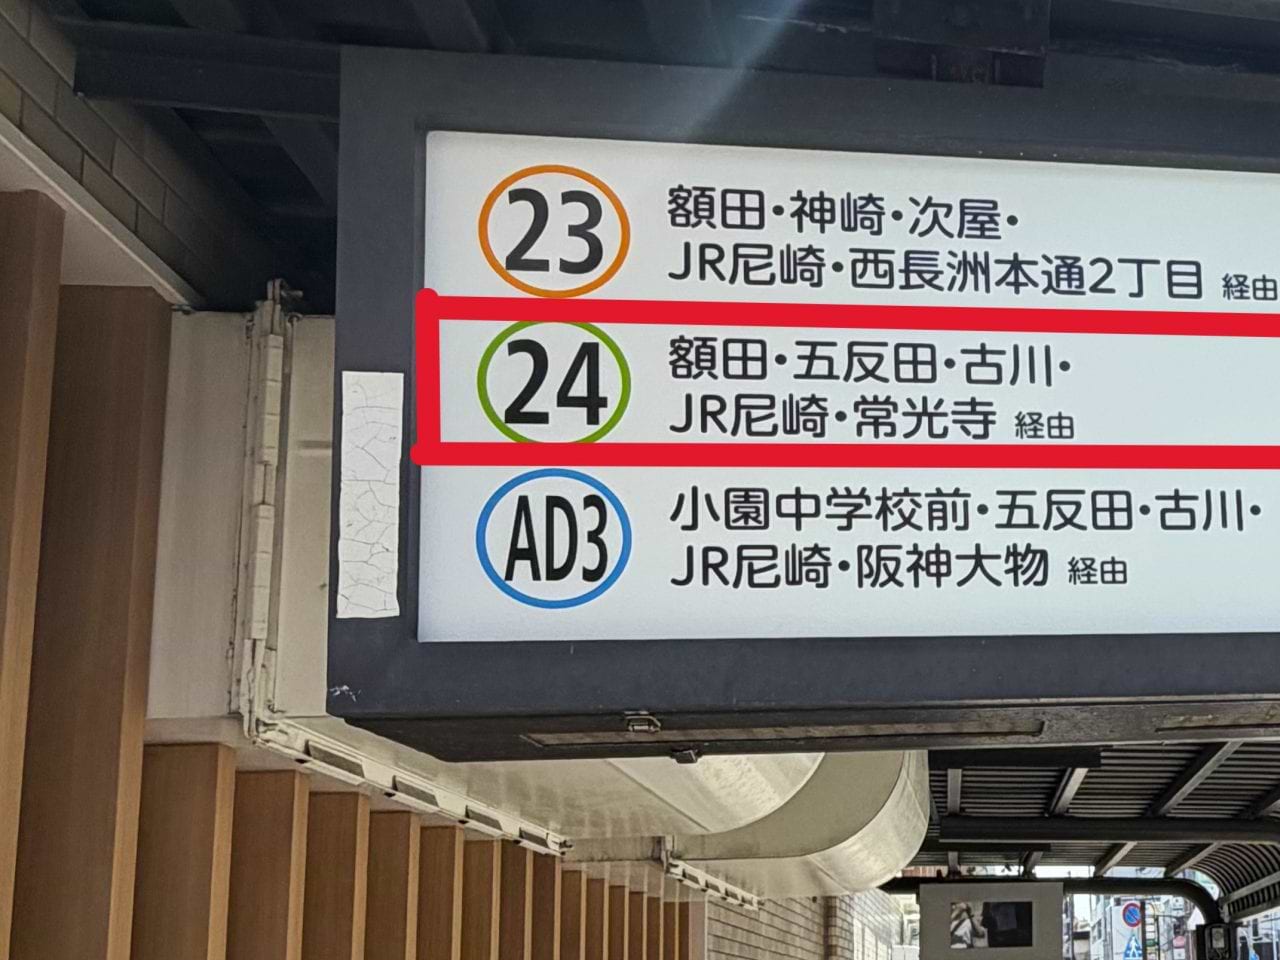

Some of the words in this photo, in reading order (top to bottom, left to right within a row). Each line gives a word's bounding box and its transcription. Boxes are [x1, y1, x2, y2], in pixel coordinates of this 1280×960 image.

[504, 186, 604, 275] 23
[667, 241, 1203, 300] JR尼崎・西長洲本通2丁目
[1221, 273, 1279, 302] 経由
[503, 338, 608, 426] 24
[669, 392, 997, 440] JR尼崎・常光寺
[1014, 410, 1075, 440] 経由
[503, 493, 609, 583] AD3
[670, 542, 1049, 590] JR尼崎・阪神大物
[1067, 556, 1128, 586] 経由
